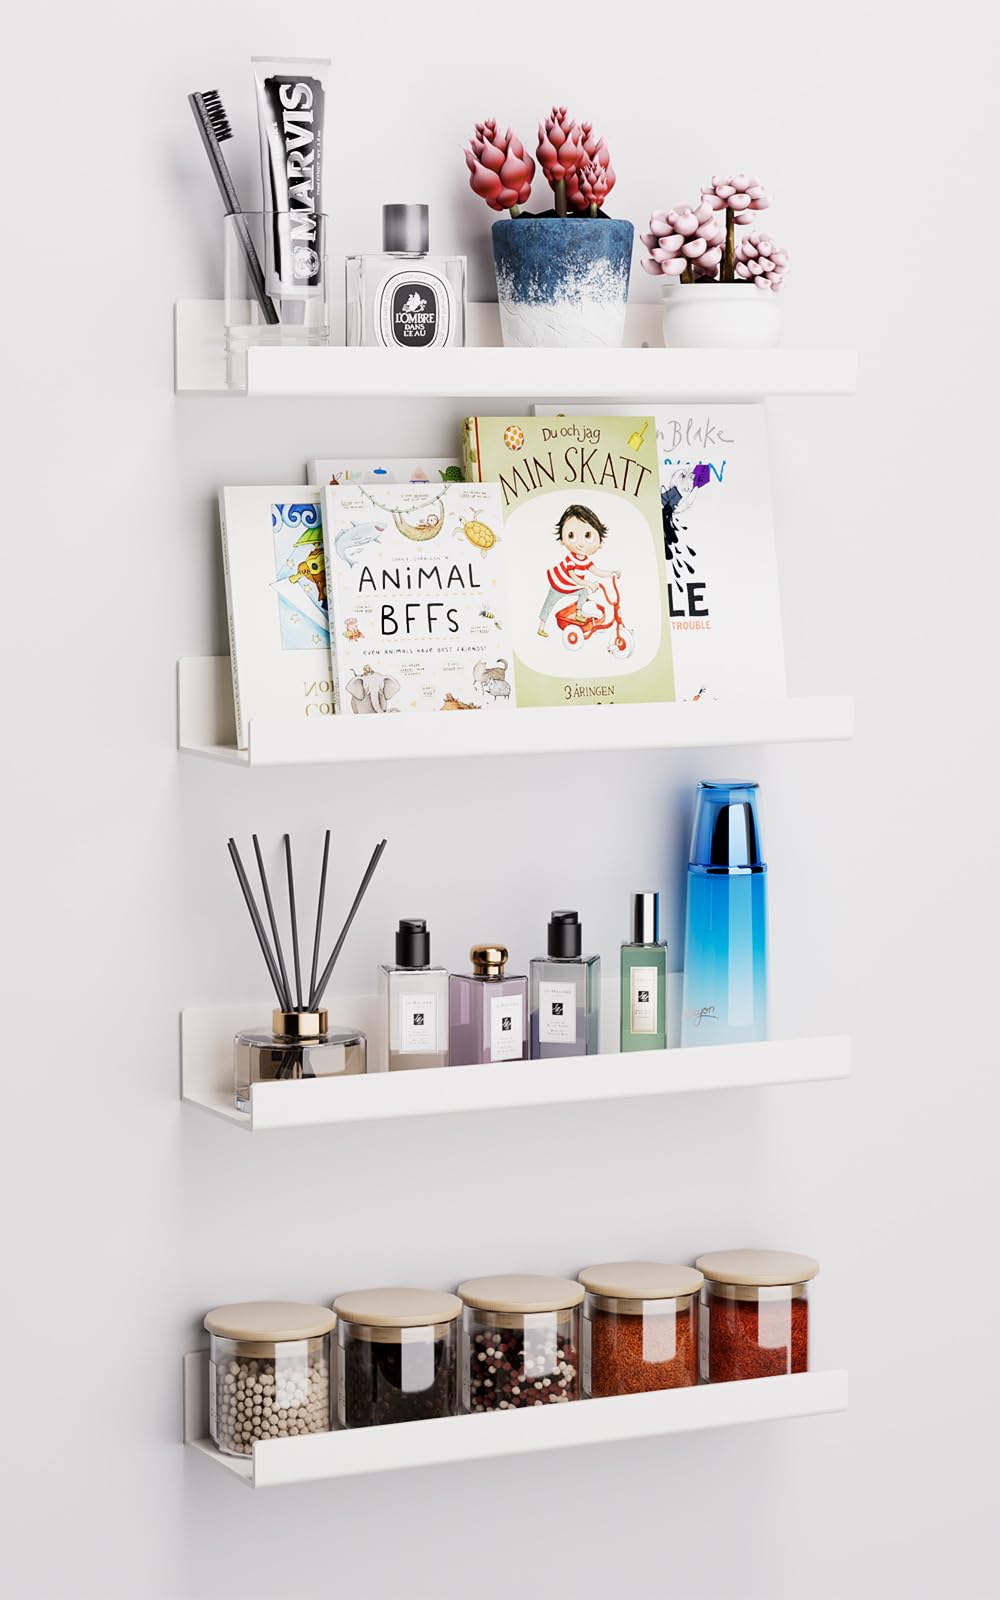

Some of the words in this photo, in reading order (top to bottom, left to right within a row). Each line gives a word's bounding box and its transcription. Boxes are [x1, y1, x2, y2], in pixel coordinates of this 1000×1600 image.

[278, 82, 316, 242] MARVIS
[404, 323, 425, 331] DANS
[542, 427, 558, 442] Du
[560, 424, 580, 437] och
[577, 425, 601, 444] jag
[663, 416, 735, 453] Blake
[499, 451, 556, 506] MIN
[564, 446, 652, 498] SKATT
[381, 603, 459, 636] BFFs
[671, 620, 712, 631] TROUBLE
